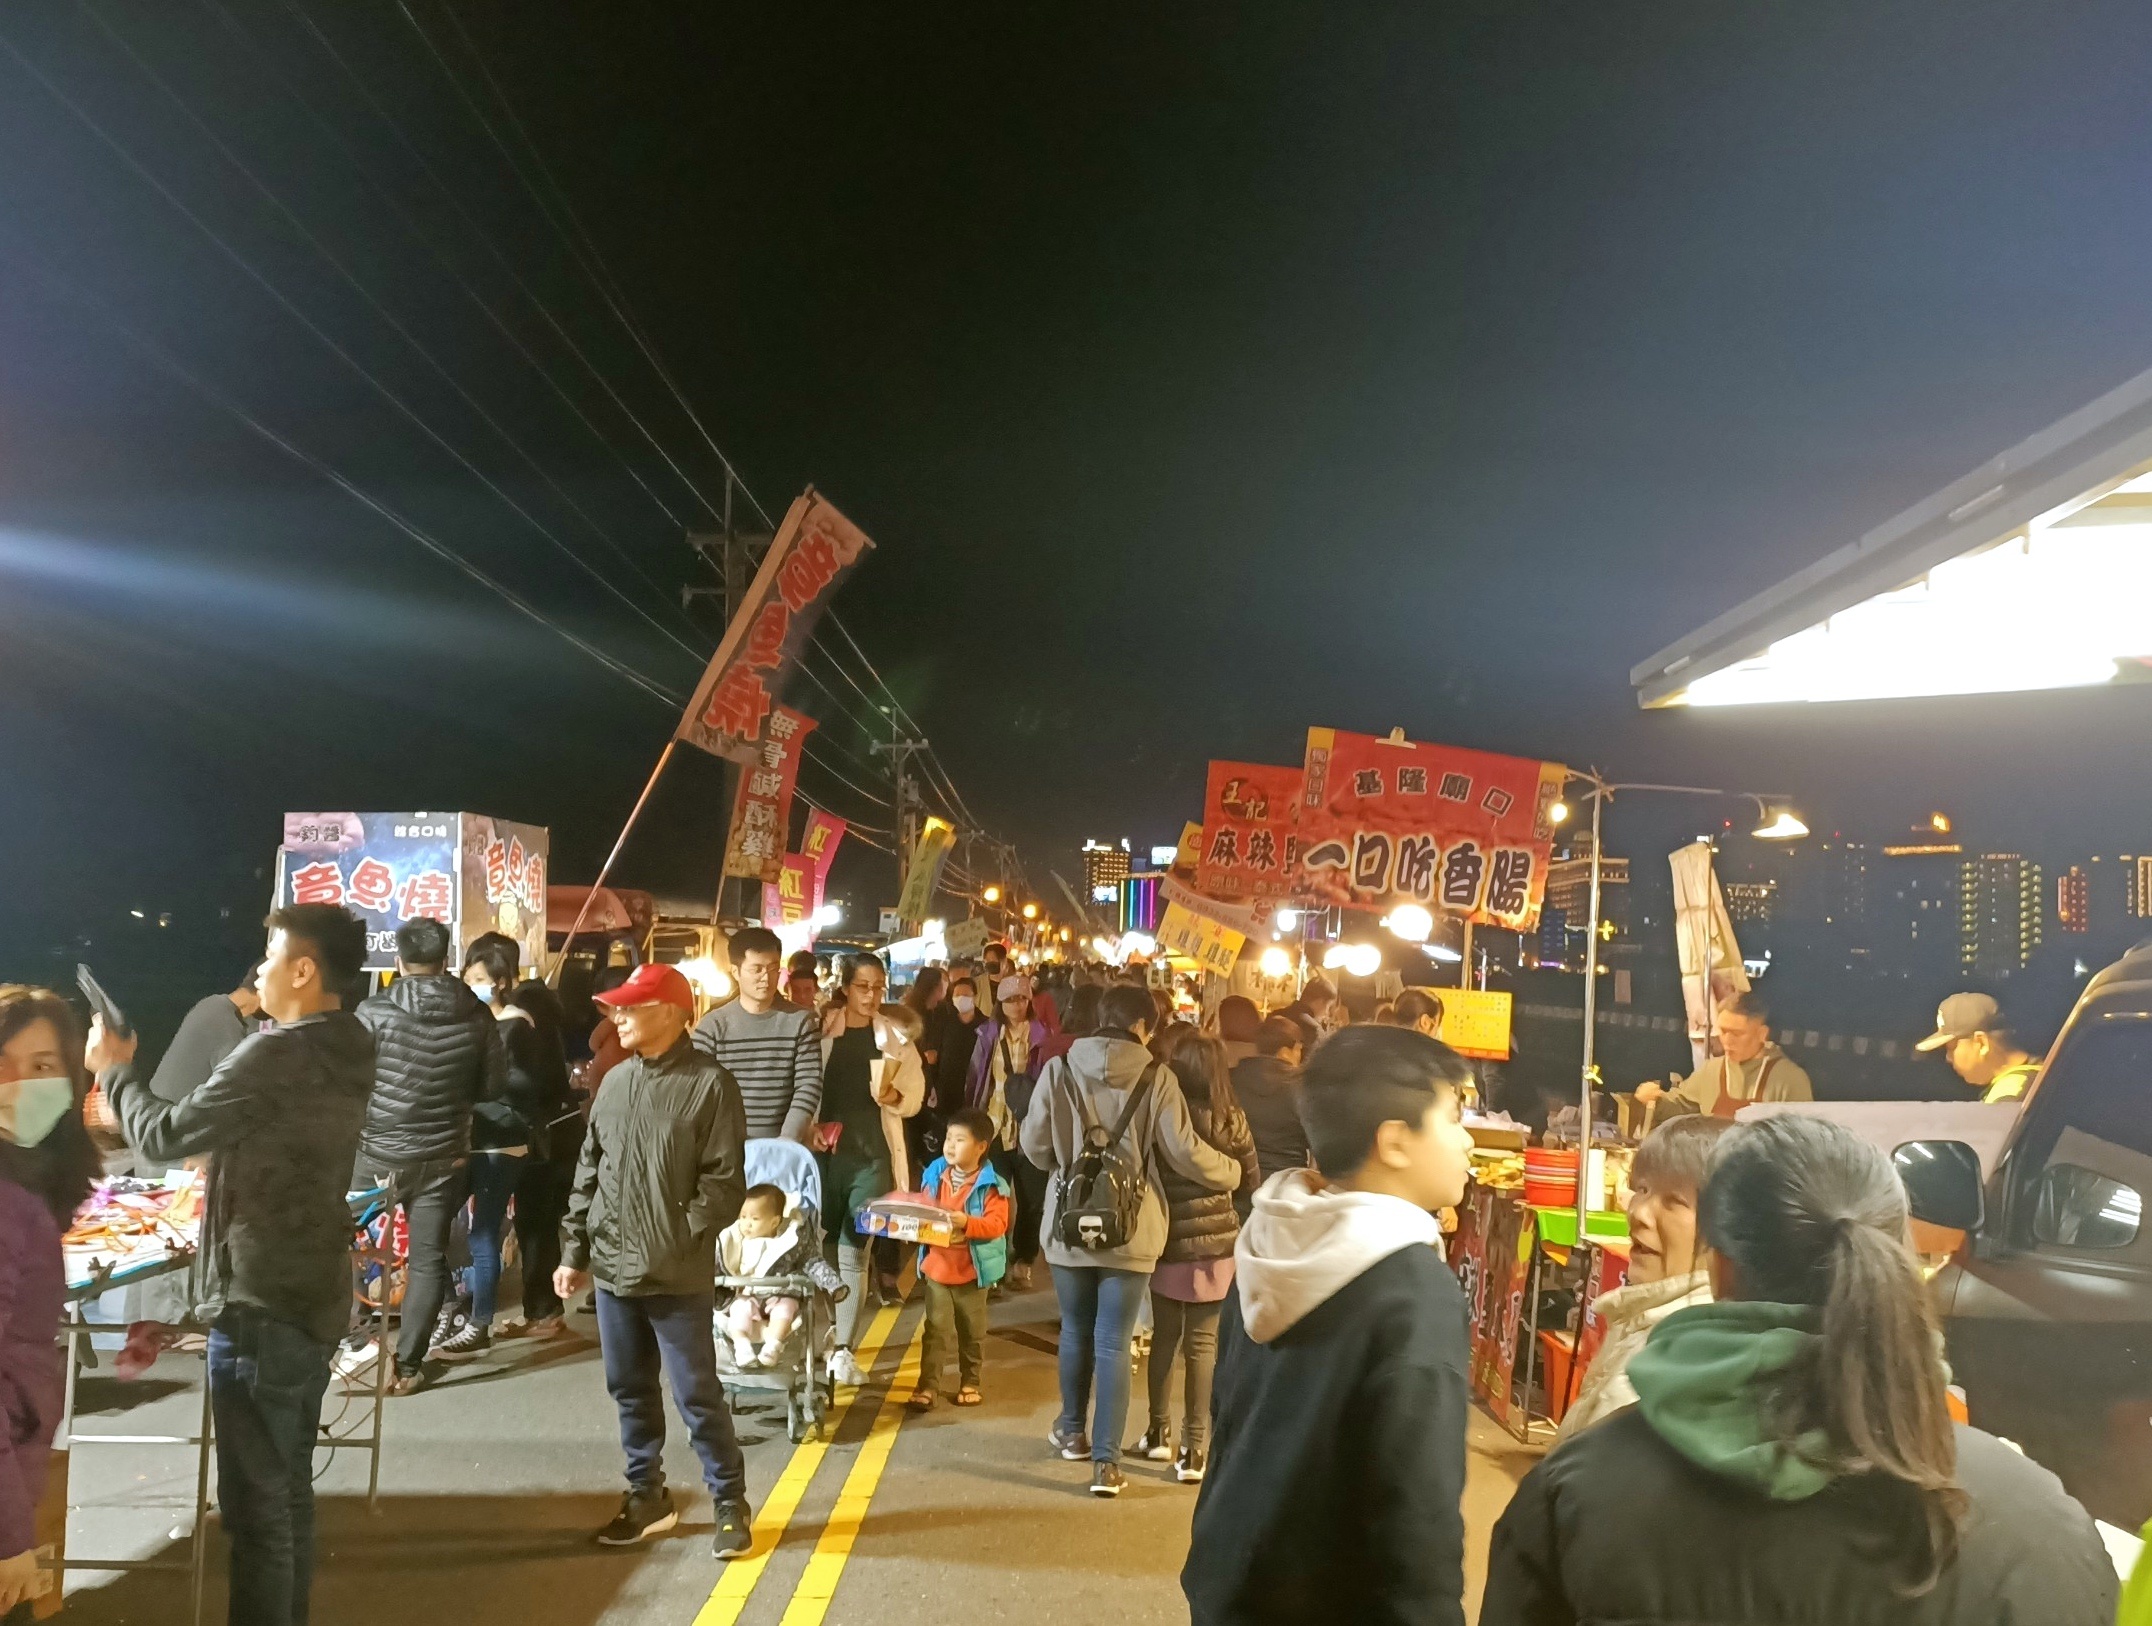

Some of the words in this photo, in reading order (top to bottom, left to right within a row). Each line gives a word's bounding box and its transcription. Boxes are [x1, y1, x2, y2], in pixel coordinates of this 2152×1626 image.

[1354, 766, 1514, 818] 基隆廟口
[291, 856, 454, 925] 章魚燒
[486, 835, 543, 913] 章魚燒
[1303, 831, 1532, 922] 一口吃香腸
